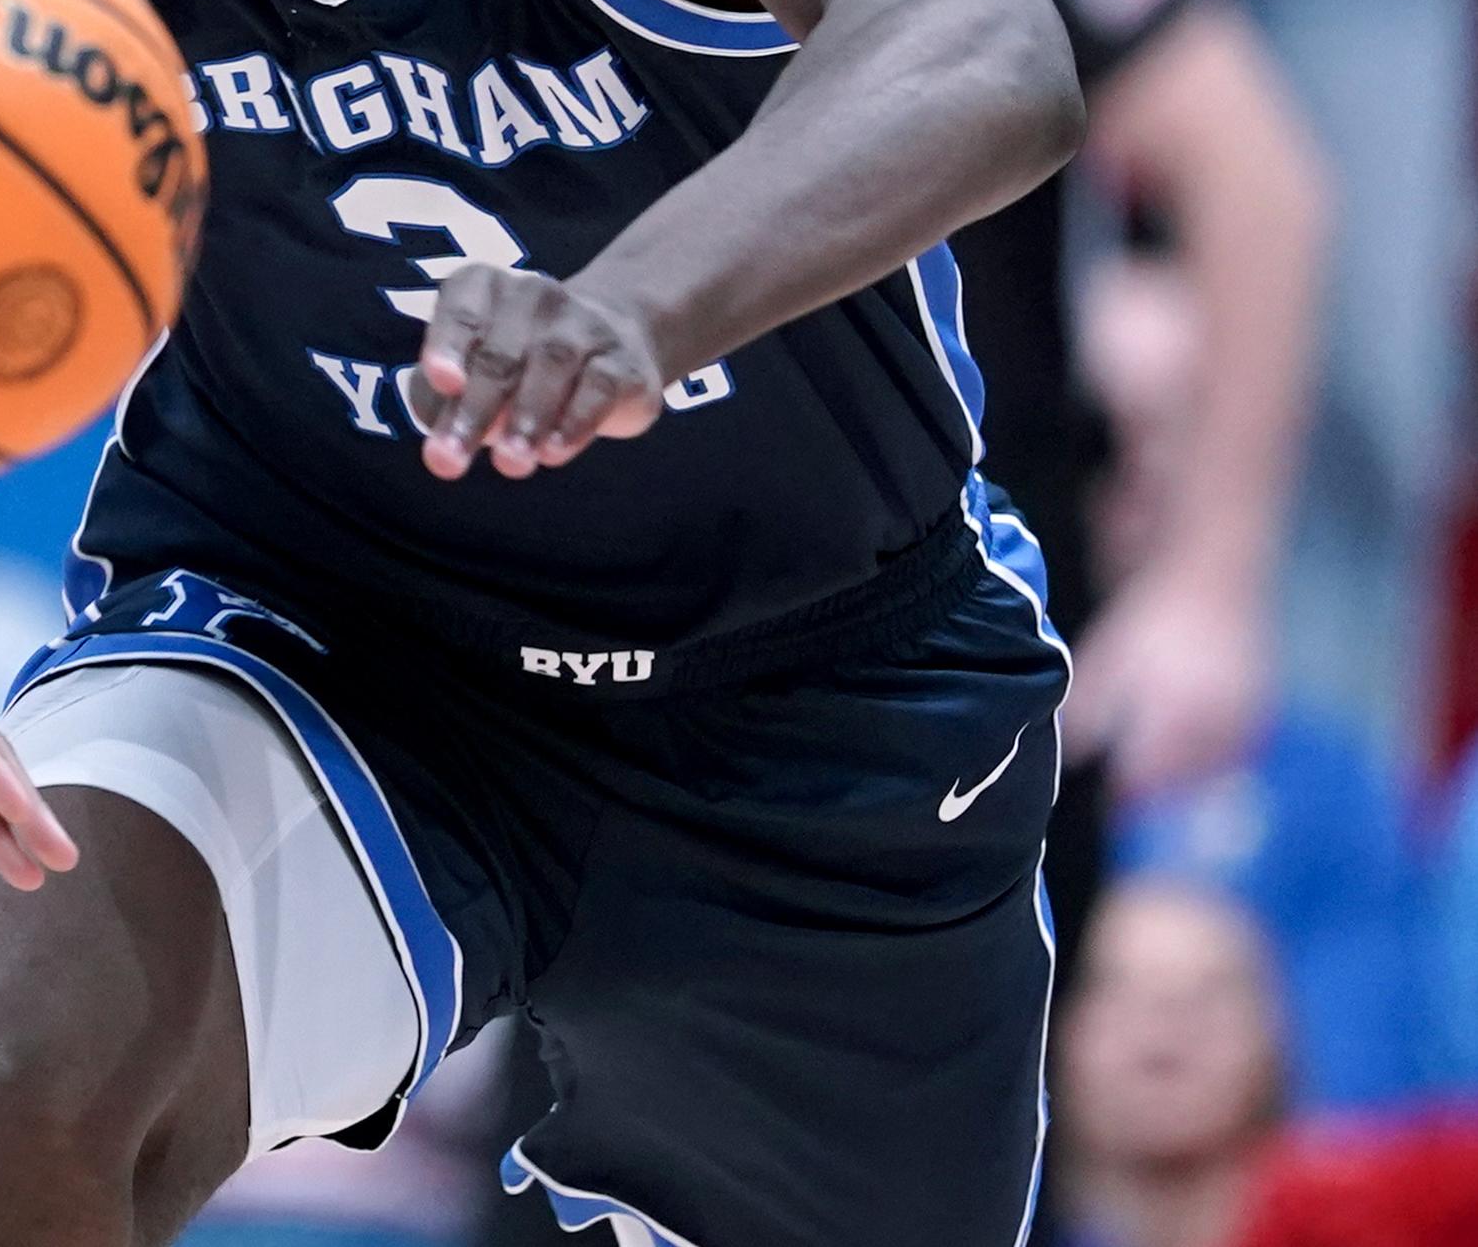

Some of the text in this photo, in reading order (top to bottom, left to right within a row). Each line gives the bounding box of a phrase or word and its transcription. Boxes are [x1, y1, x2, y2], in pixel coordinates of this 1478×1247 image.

[5, 4, 199, 230] lson
[179, 46, 652, 168] RGHAM
[520, 645, 655, 686] BYU
